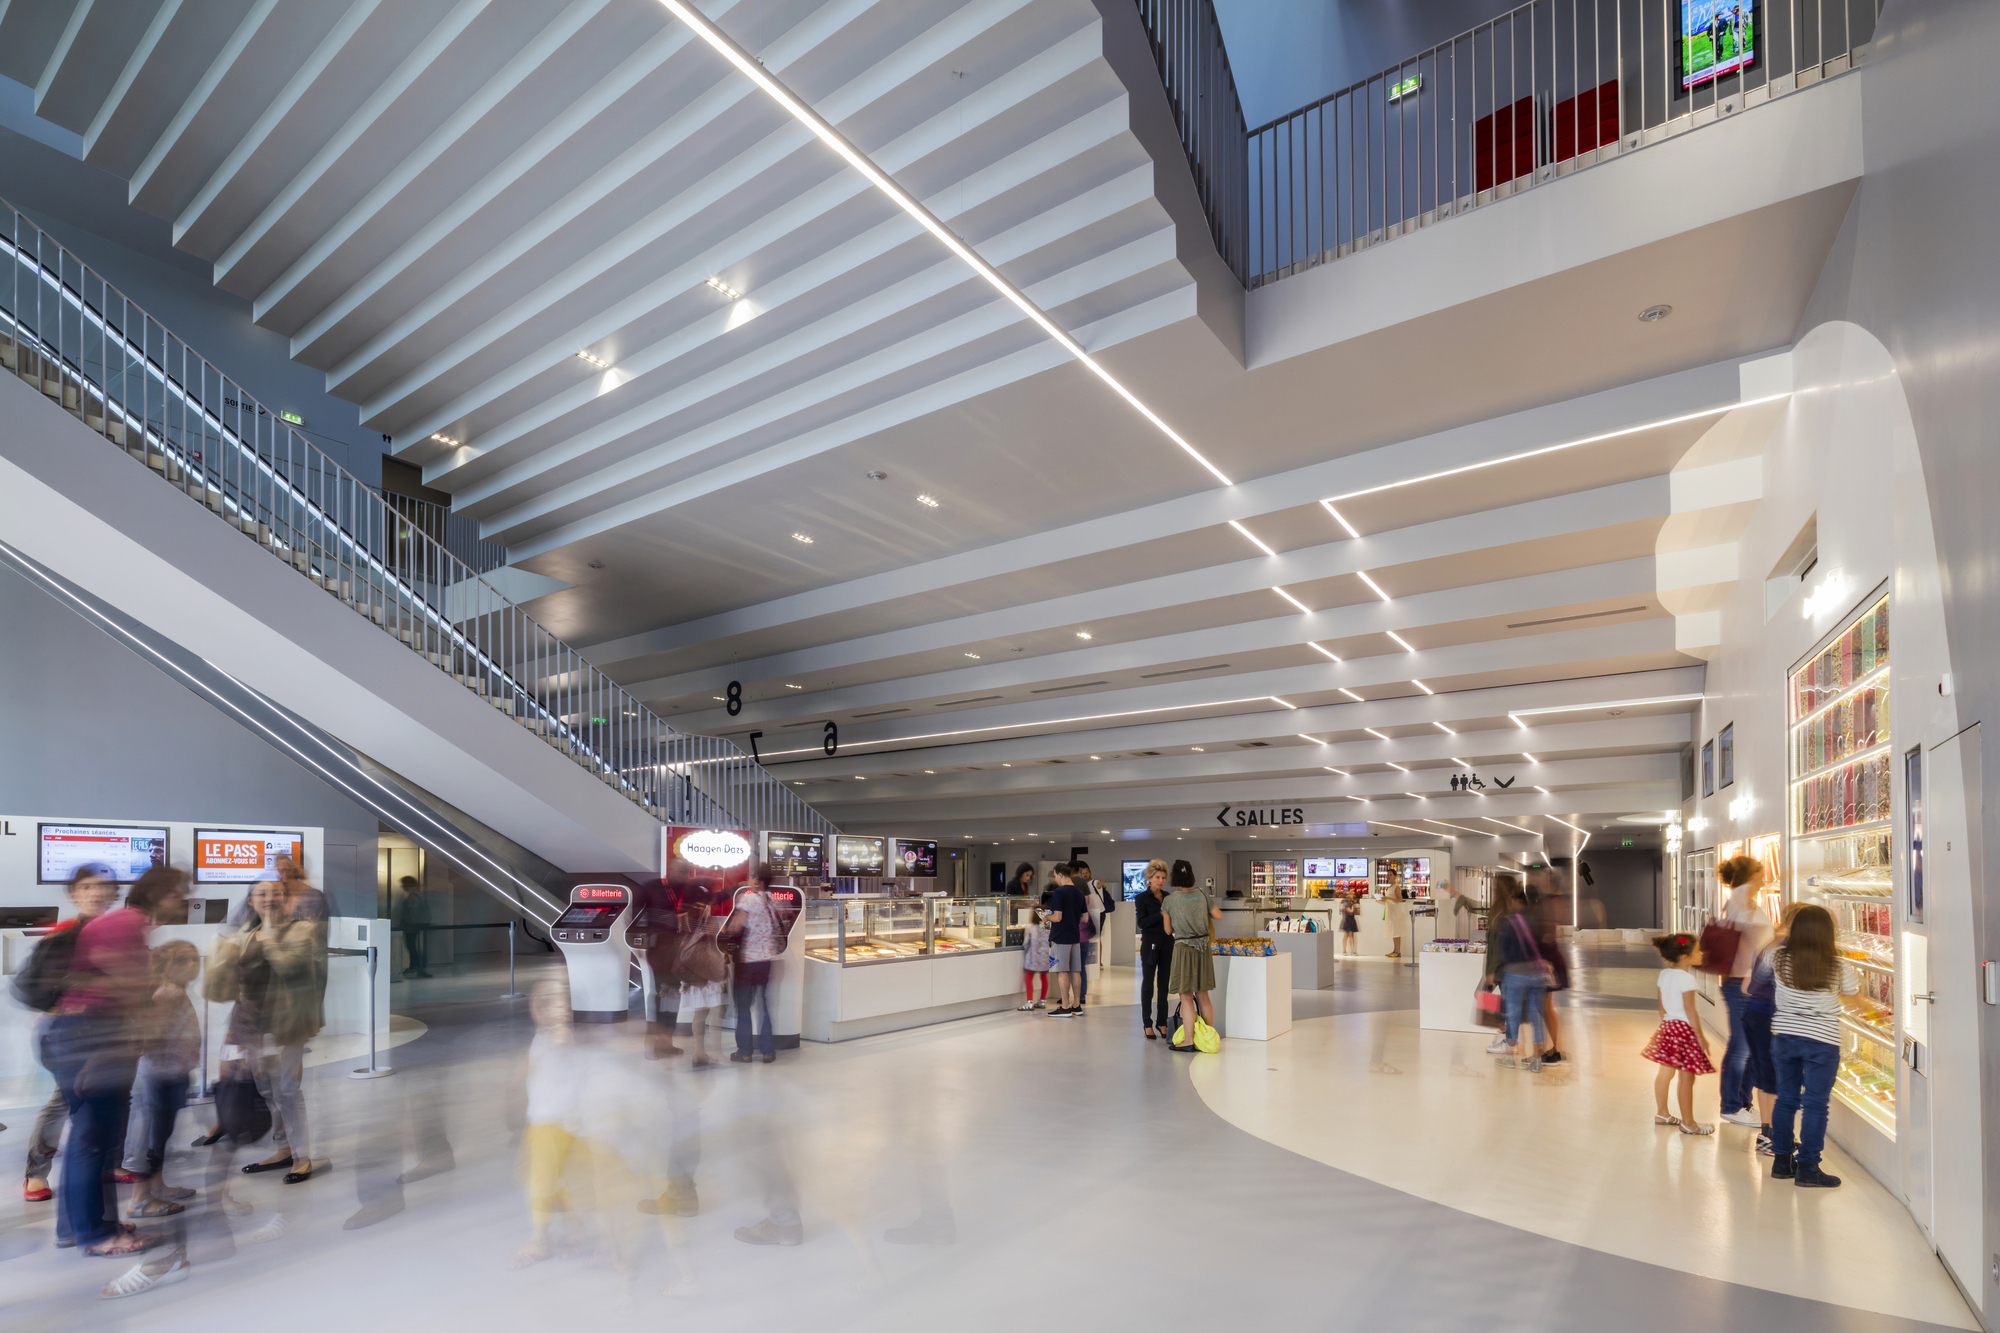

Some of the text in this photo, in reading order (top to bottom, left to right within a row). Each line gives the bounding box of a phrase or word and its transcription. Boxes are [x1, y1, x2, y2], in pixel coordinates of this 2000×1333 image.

[225, 397, 254, 413] SORTIE
[726, 680, 742, 716] 8
[1236, 808, 1304, 826] SALLES
[205, 843, 222, 857] LE
[224, 843, 258, 857] PASS
[205, 857, 249, 865] ABONNEZ-VOUS
[591, 889, 622, 898] Billetterie
